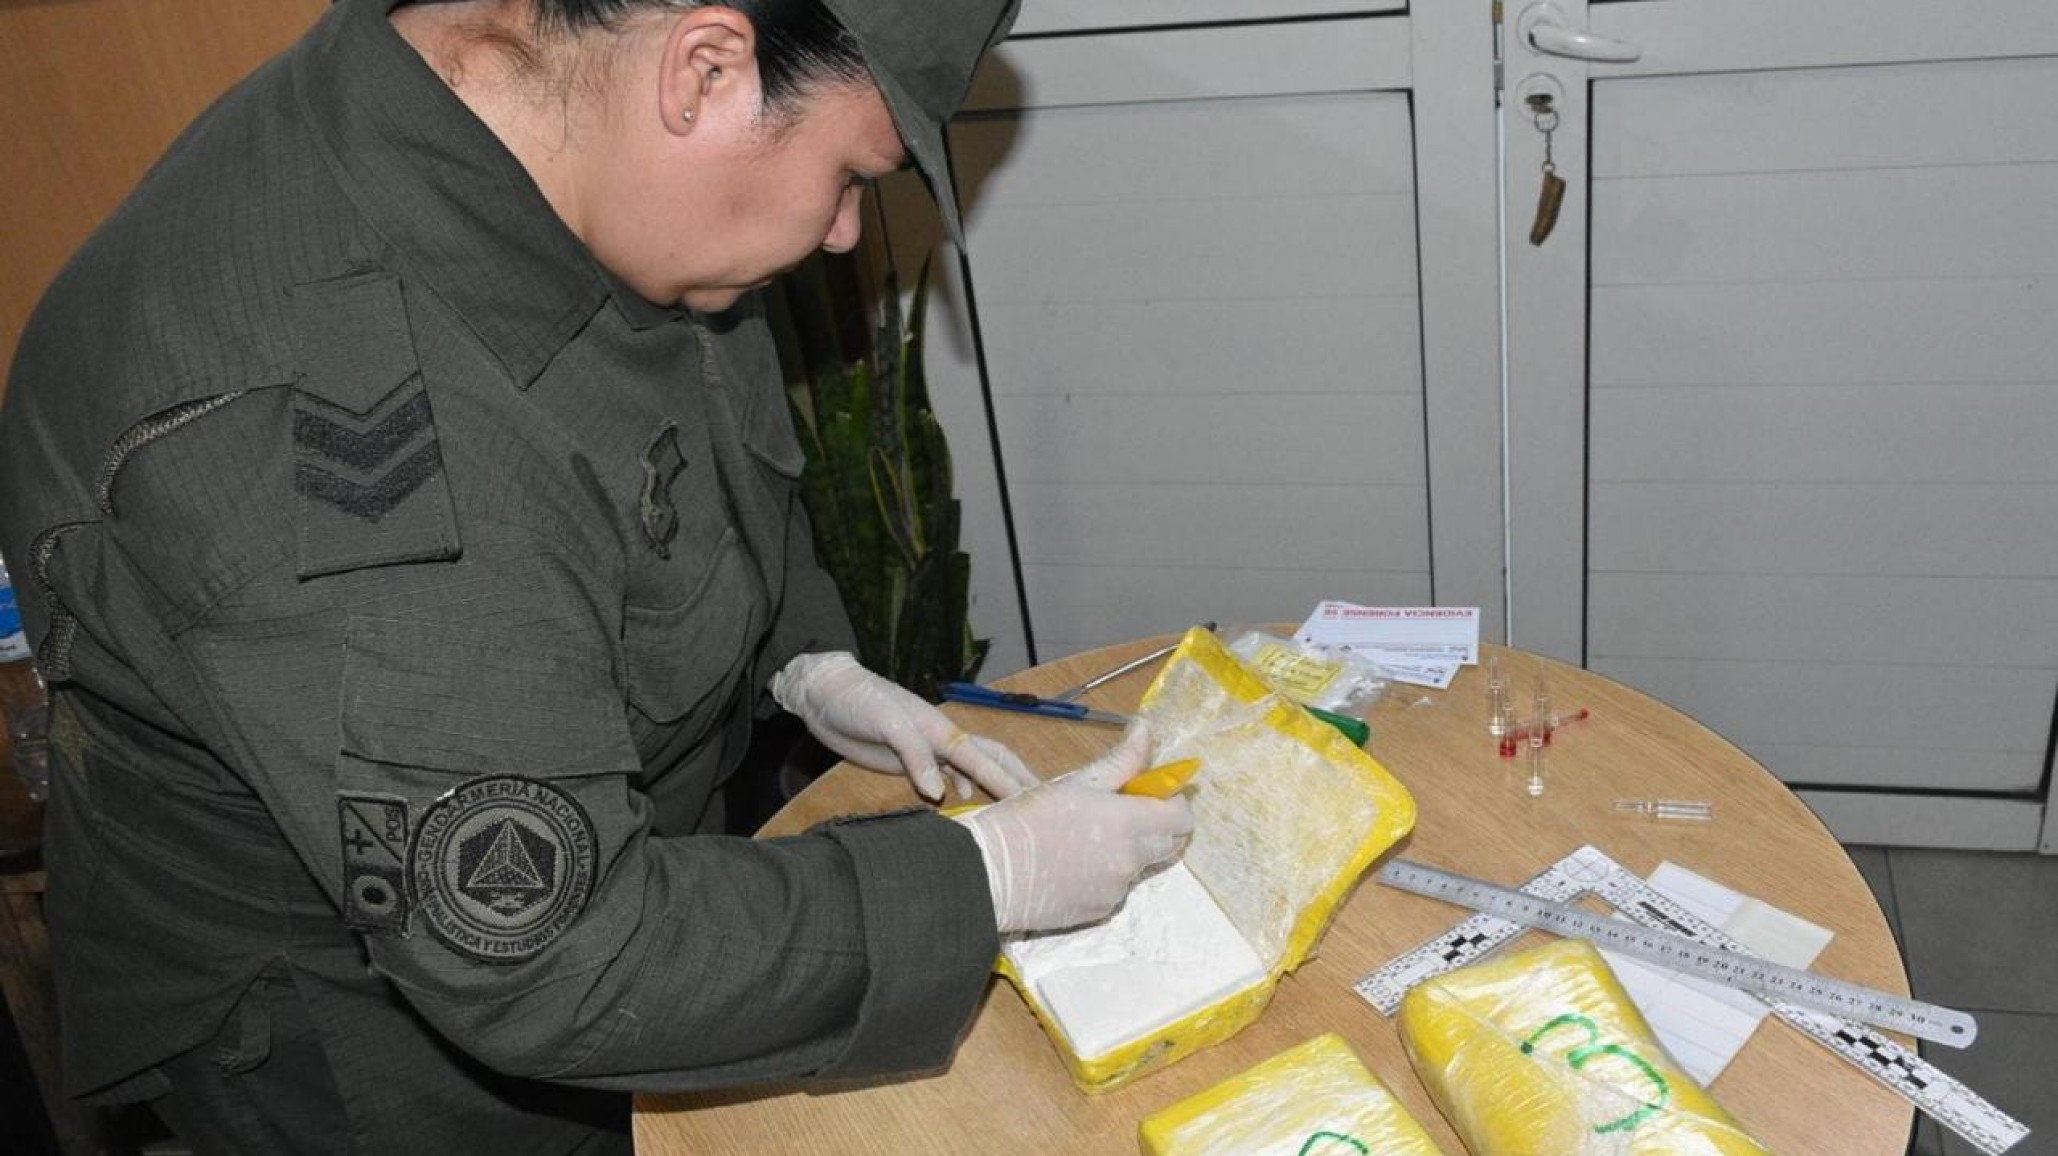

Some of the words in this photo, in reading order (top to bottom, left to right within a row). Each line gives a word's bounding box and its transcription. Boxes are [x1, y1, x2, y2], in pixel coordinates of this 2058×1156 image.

[1342, 609, 1401, 618] FORENSE
[1403, 609, 1473, 618] EVIDENCIA
[384, 805, 401, 842] POS
[536, 788, 589, 864] NACIONAL
[1520, 1012, 1672, 1134] 3
